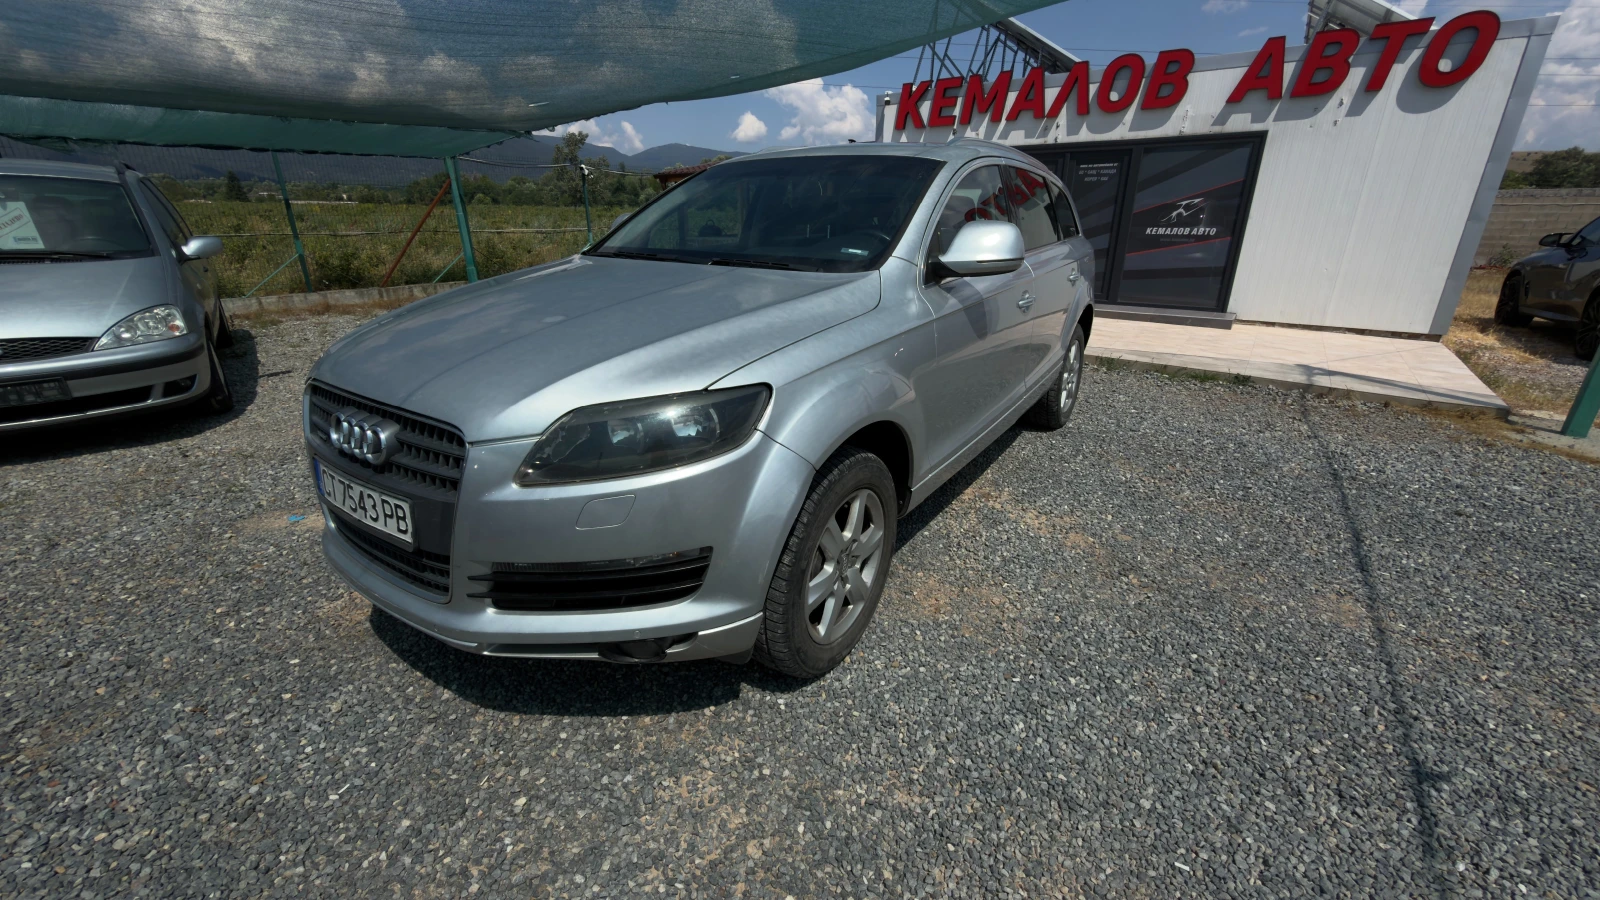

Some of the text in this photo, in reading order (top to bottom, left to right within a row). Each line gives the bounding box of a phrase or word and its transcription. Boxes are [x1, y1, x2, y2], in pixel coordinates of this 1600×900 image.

[895, 9, 1501, 130] КЕМАЛОВ АВТО
[1145, 227, 1217, 236] КЕМАЛОВ АВТО
[321, 468, 409, 534] CT 7543 PB
